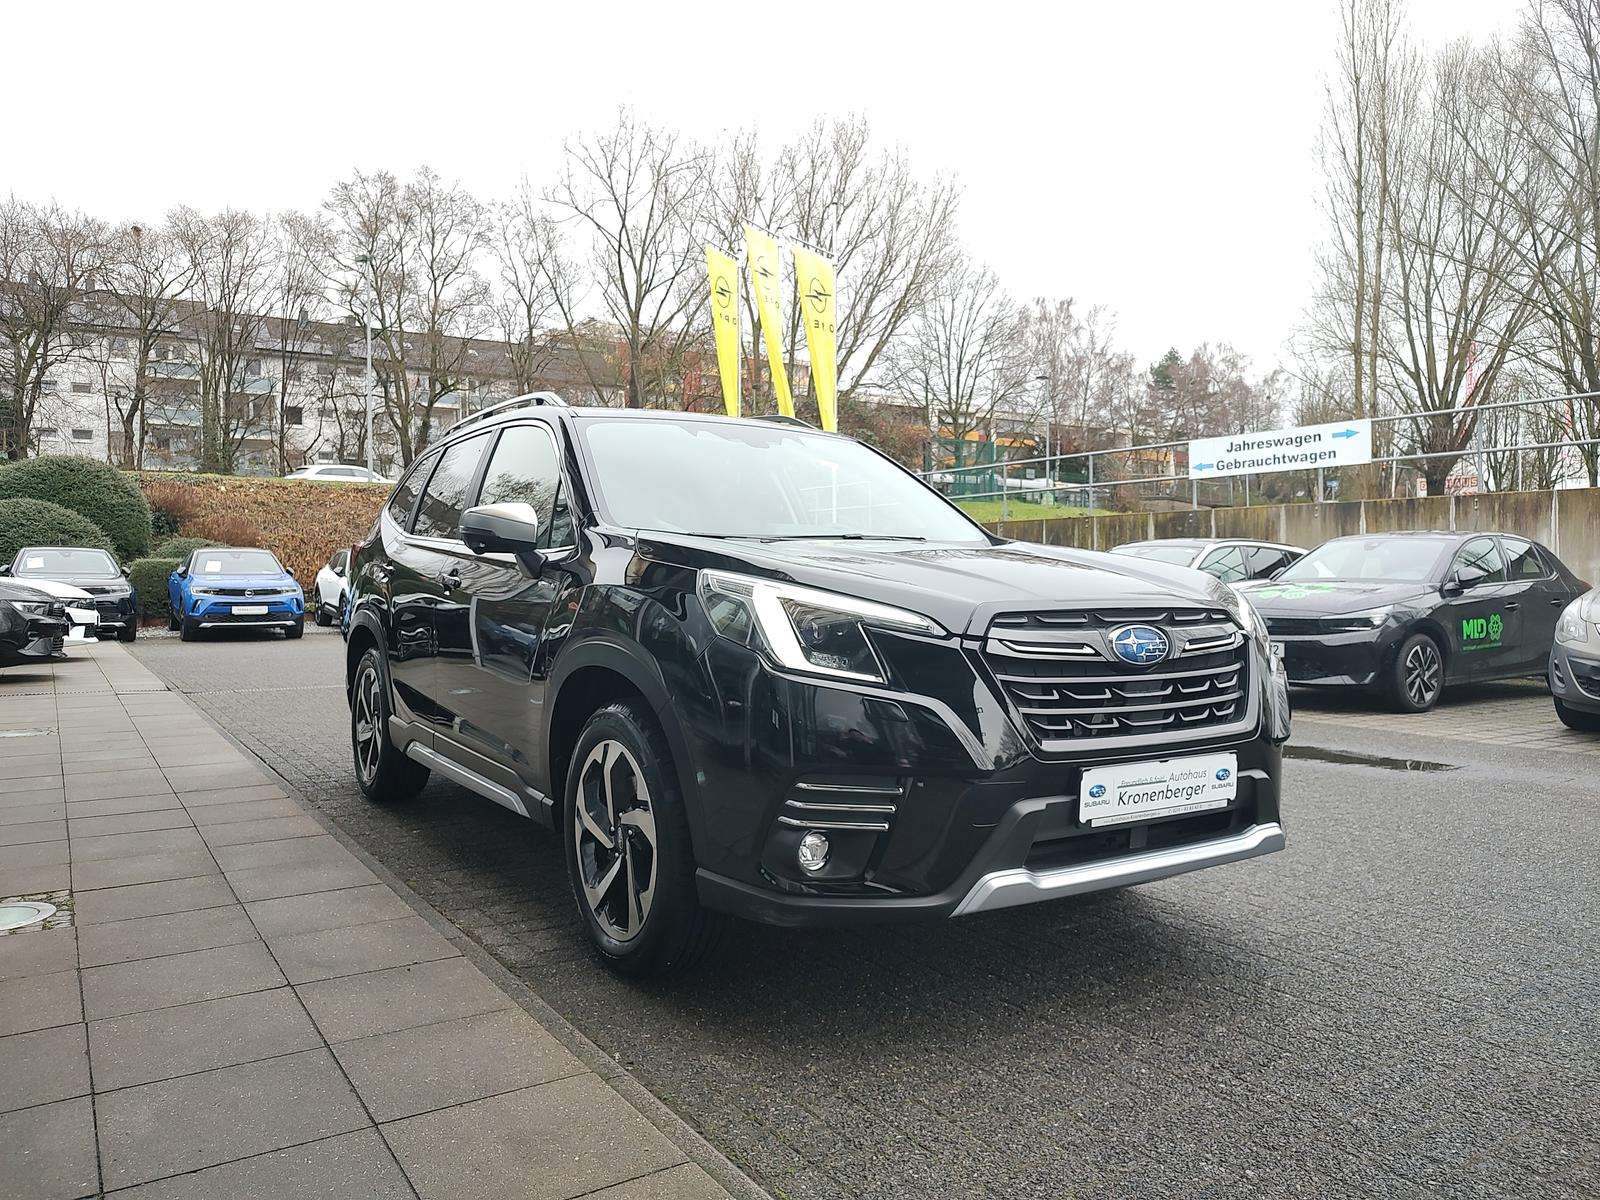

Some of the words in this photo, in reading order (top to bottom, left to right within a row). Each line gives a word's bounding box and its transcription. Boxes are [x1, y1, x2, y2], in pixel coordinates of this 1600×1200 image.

[1226, 431, 1322, 453] Jahreswagen
[1216, 449, 1337, 471] Gebrauchtwagen
[1462, 618, 1487, 640] MLD
[1168, 769, 1207, 782] Autohaus
[1211, 782, 1234, 790] SUBARU
[1084, 799, 1110, 808] SUBARU
[1117, 783, 1207, 806] Kronenberger
